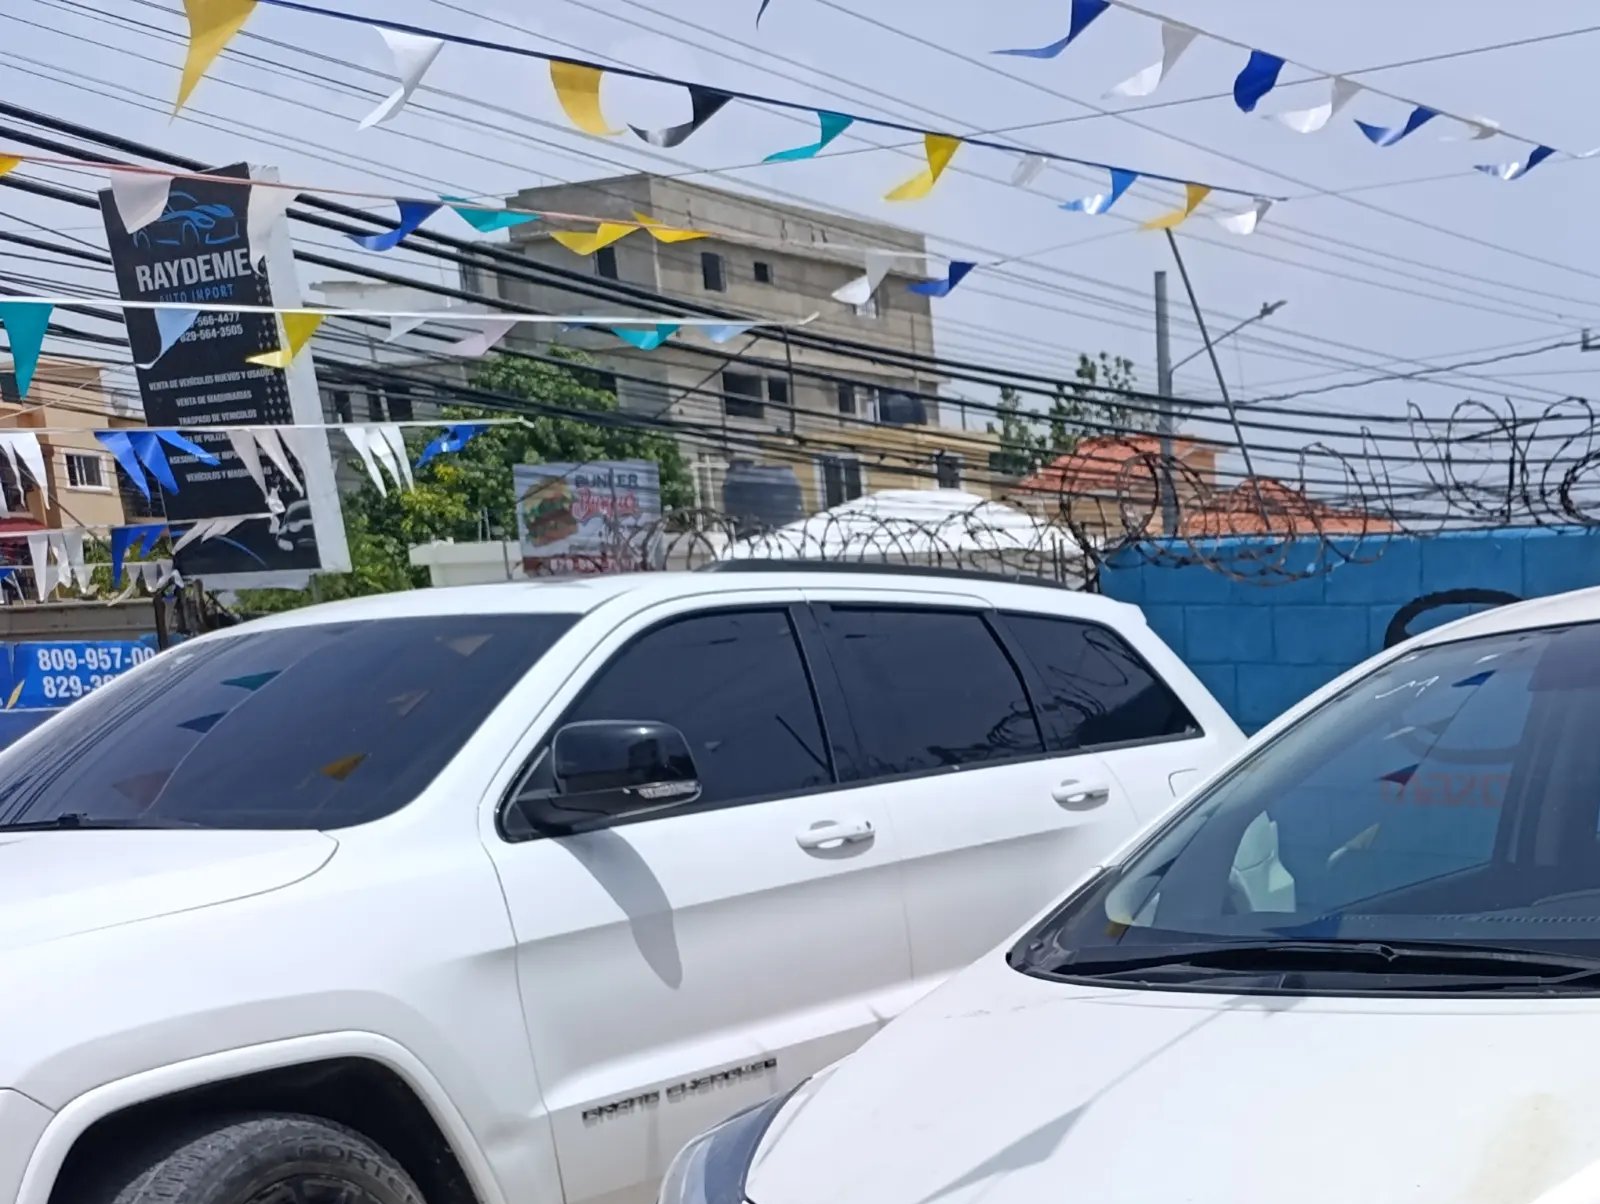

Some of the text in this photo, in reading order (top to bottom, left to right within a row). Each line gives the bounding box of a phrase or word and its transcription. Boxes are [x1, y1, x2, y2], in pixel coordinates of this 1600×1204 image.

[135, 248, 252, 292] RAYDEME
[191, 284, 234, 301] IMPORT
[575, 473, 640, 489] BUNER
